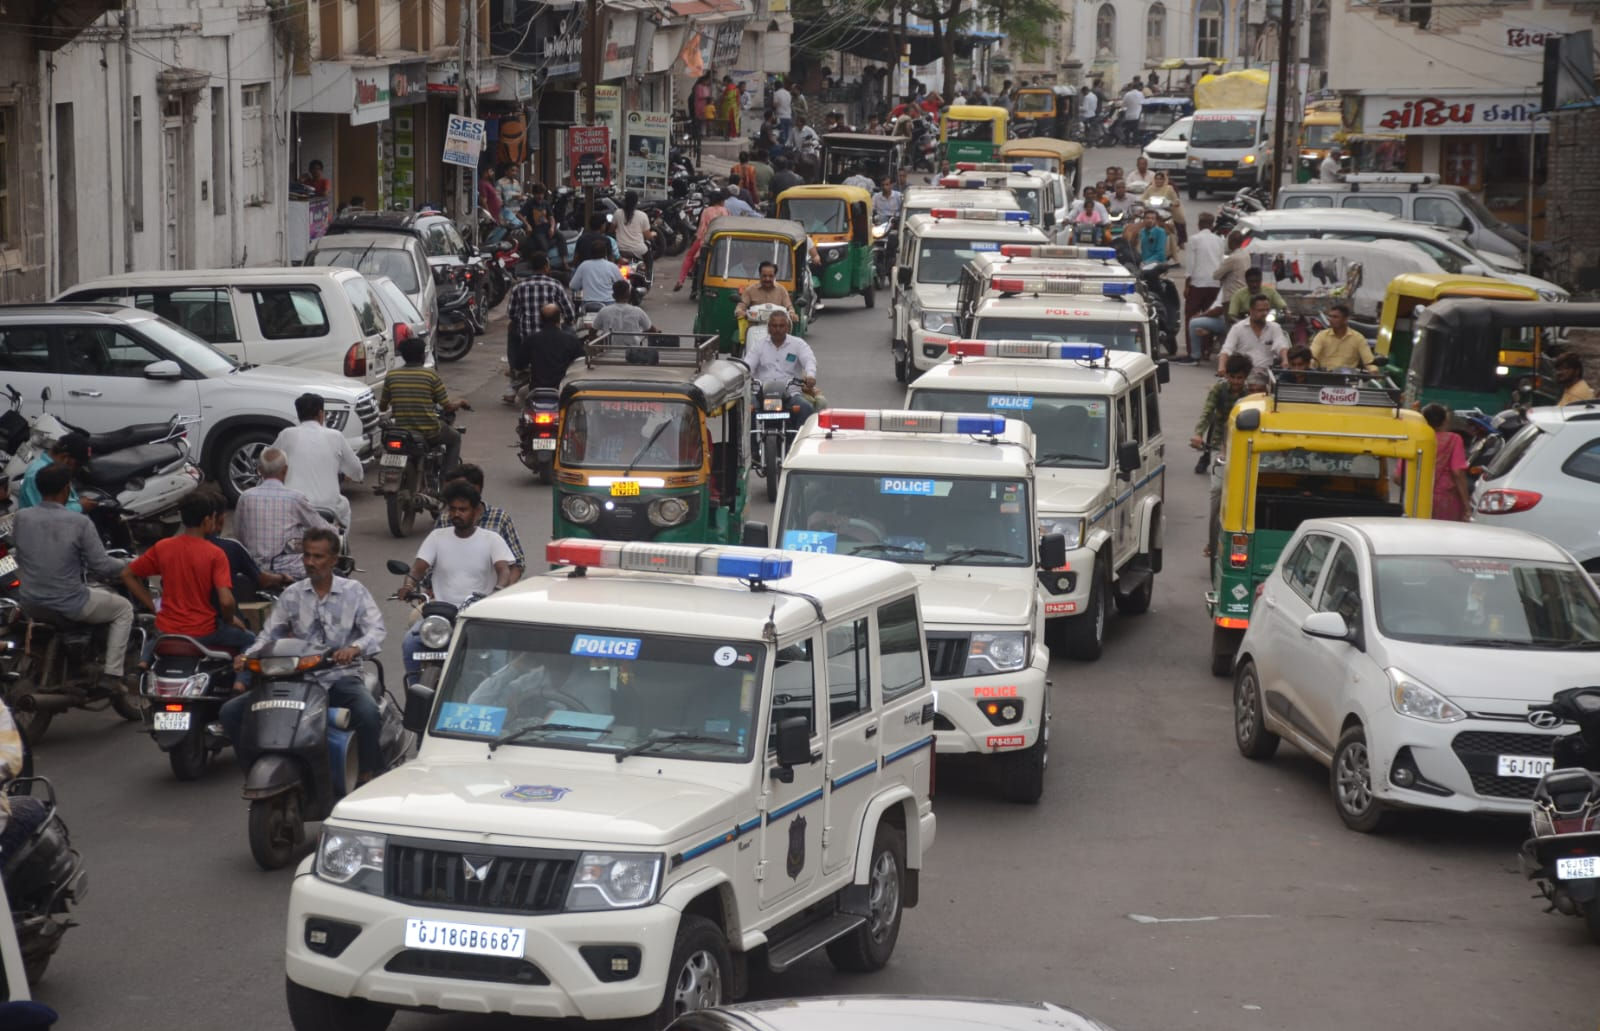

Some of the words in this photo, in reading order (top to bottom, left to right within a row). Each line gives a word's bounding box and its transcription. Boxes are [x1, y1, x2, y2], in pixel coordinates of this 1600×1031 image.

[1507, 28, 1553, 47] શિવ
[450, 118, 482, 134] SES
[449, 129, 480, 141] SCHOOLS
[1045, 308, 1091, 317] POLCE
[991, 397, 1030, 408] POLICE
[884, 479, 931, 493] POLICE
[574, 638, 637, 656] POLICE
[722, 652, 730, 661] 5
[974, 686, 1017, 697] POLICE
[418, 925, 520, 952] GJ18GB6687
